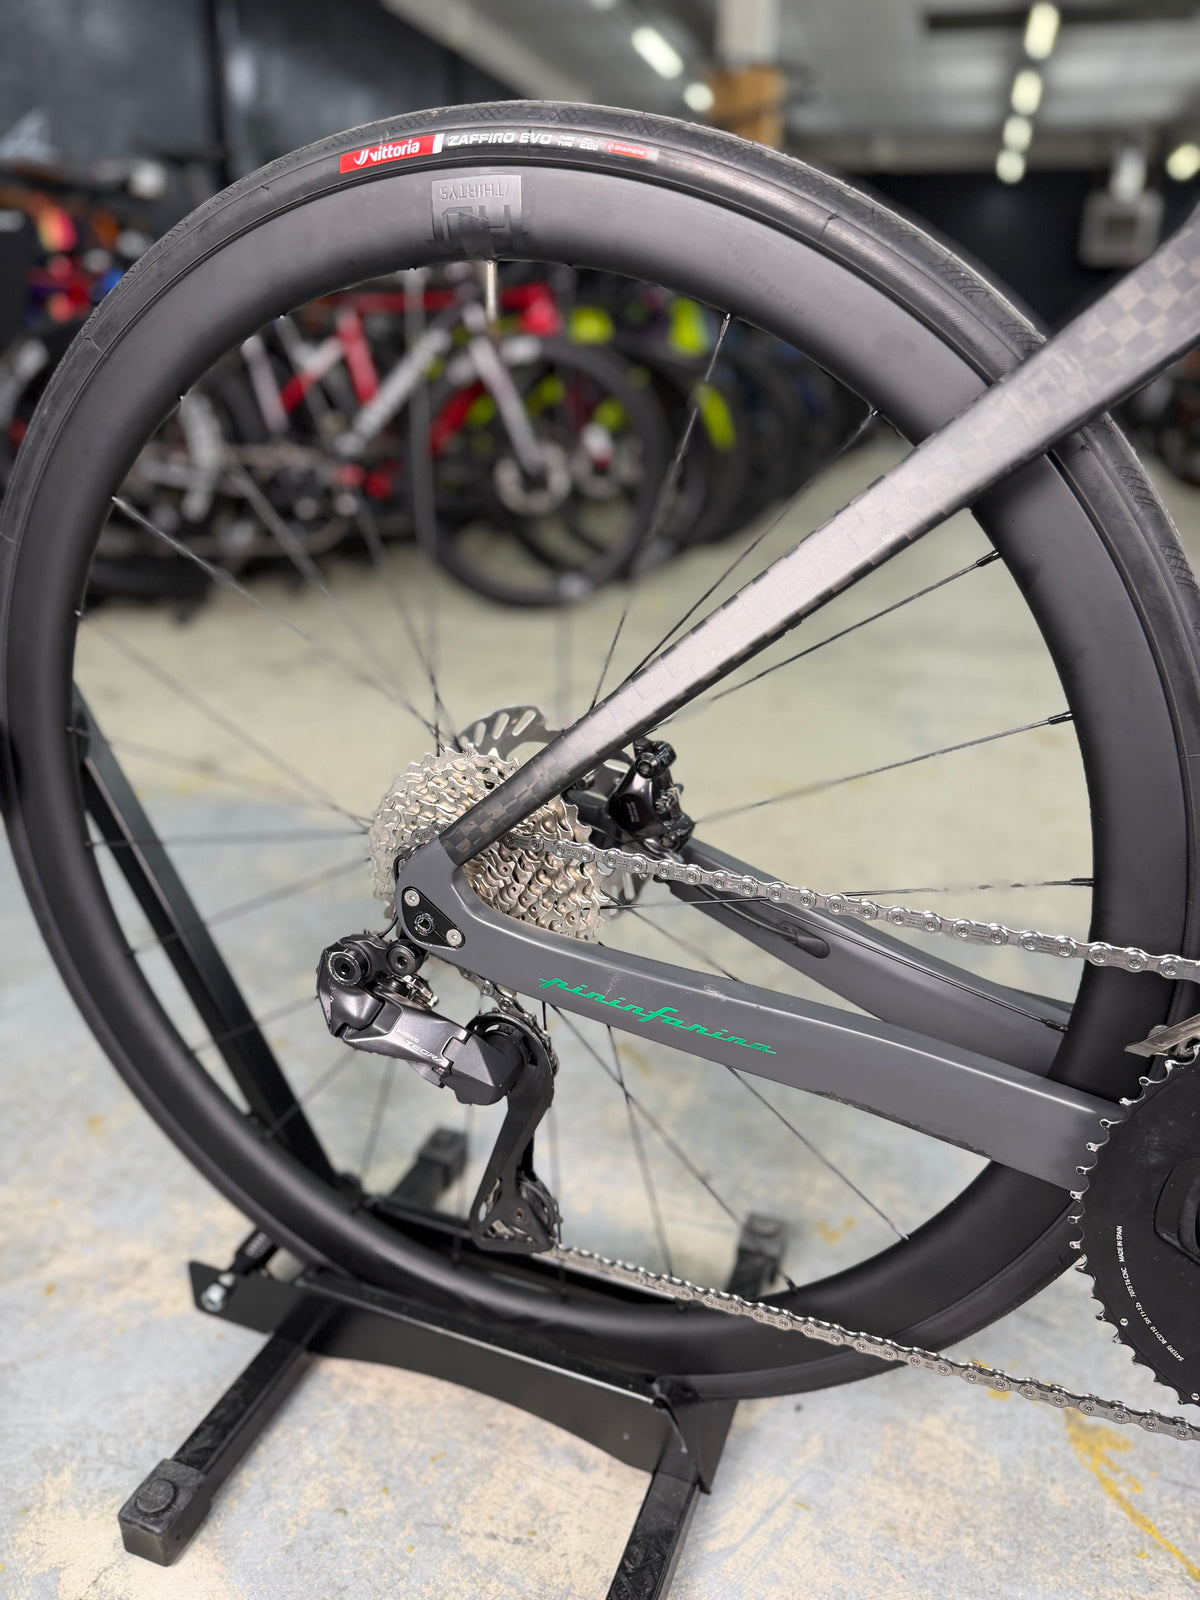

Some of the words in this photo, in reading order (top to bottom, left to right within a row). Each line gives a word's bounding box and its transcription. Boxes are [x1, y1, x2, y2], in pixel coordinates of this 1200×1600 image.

[447, 133, 516, 146] ZAFFIRO
[518, 133, 553, 145] EVO
[370, 139, 420, 162] vittoria
[538, 977, 777, 1055] pininfarina
[1115, 1225, 1123, 1241] SPAIN
[1116, 1246, 1125, 1263] MADE
